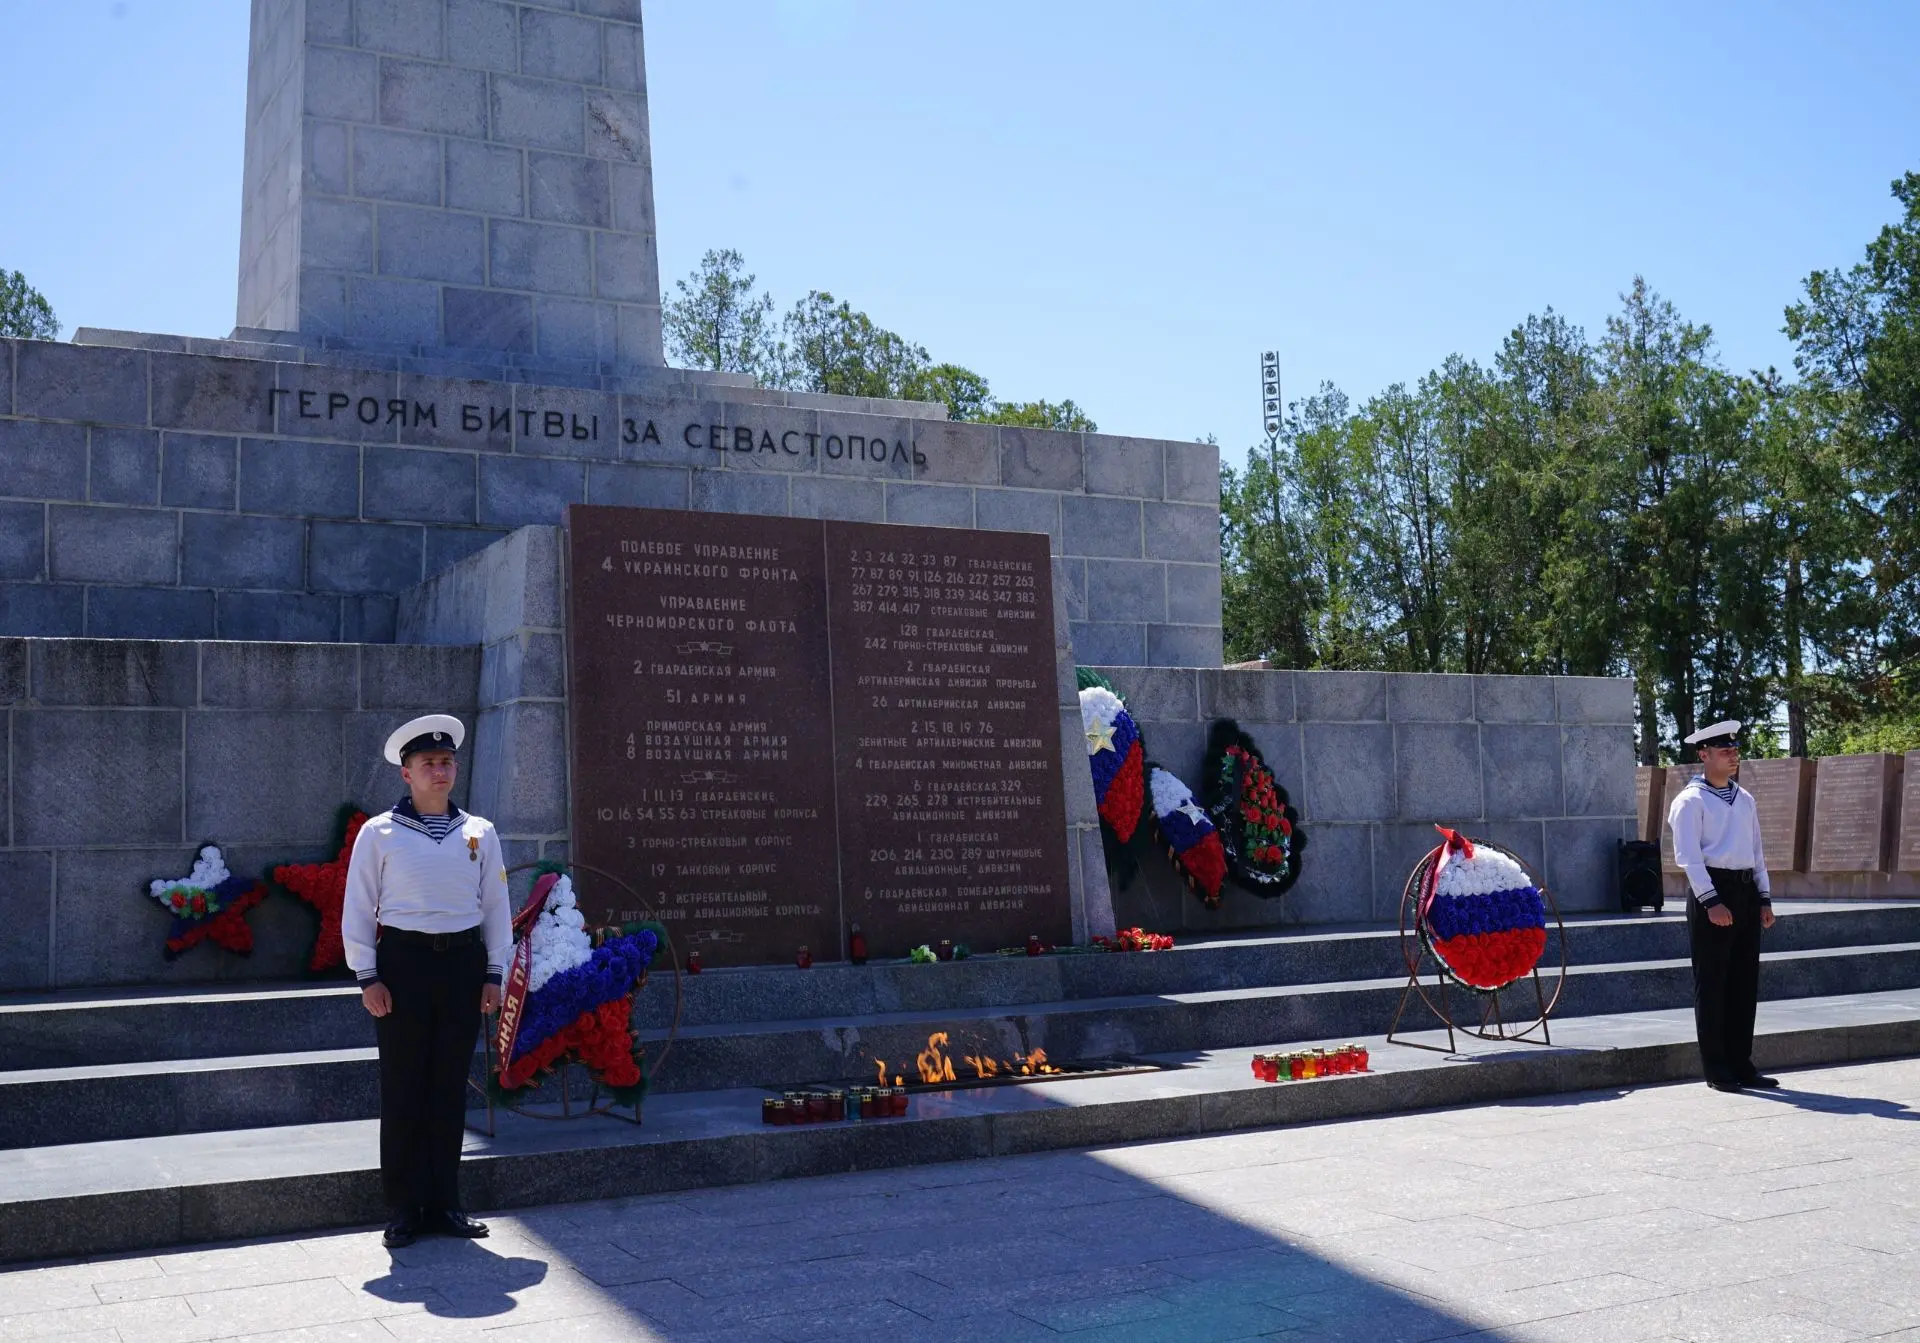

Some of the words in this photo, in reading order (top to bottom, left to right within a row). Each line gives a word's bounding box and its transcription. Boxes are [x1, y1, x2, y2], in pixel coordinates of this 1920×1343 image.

[268, 388, 437, 429] ГЕРОЯМ
[462, 404, 598, 441] БИТВЫ
[622, 418, 661, 445] ЗА
[684, 423, 927, 466] СЕВАСТОПОЛЬ
[621, 540, 682, 556] ПОЛЕВОЕ
[694, 543, 779, 561] УПРАВЛЕНИЕ
[601, 556, 613, 572] 4
[624, 560, 729, 579] УКРАИНСКОГО
[739, 567, 798, 582] ФРОНТА
[659, 595, 747, 612] УПРАВЛЕНИЕ
[902, 602, 920, 615] 417
[930, 606, 988, 618] СТРЕЛКОВЫЕ
[997, 609, 1036, 620] ДИВИЗИИ
[606, 614, 735, 632] ЧЕРНОМОРСКОГО
[745, 619, 797, 635] ФЛОТА
[901, 623, 918, 637] 128
[864, 637, 887, 649] 242
[893, 640, 984, 652] ГОРНО-СТРЕЛКОВЫЕ
[989, 643, 1029, 654] ДИВИЗИИ
[633, 660, 643, 675] 2
[739, 666, 776, 678] АРМИЯ
[907, 660, 914, 672] 2
[947, 677, 988, 688] ДИВИЗИЯ
[996, 679, 1037, 689] ПРОРЫВА
[666, 689, 681, 704] 51
[691, 693, 746, 705] АРМИЯ
[872, 695, 888, 708] 26
[987, 700, 1026, 710] ДИВИЗИЯ
[646, 720, 722, 733] ПРИМОРСКАЯ
[729, 721, 767, 733] АРМИЯ
[979, 721, 994, 733] 76
[626, 732, 635, 745] 4
[645, 735, 732, 746] ВОЗДУШНАЯ
[743, 735, 788, 746] АРМИЯ
[858, 737, 908, 747] ЗЕНИТНЫЕ
[1003, 738, 1043, 748] ДИВИЗИИ
[626, 746, 636, 760] 8
[645, 749, 732, 761] ВОЗДУШНАЯ
[743, 750, 788, 761] АРМИЯ
[855, 757, 863, 770] 4
[942, 760, 1001, 769] МИНОМЕТНАЯ
[1008, 760, 1048, 770] ДИВИЗИЯ
[956, 795, 1042, 806] ИСТРЕБИТЕЛЬНЫЕ
[702, 809, 767, 820] СТРЕЛКОВЫЕ
[774, 808, 818, 819] КОРПУСА
[892, 810, 965, 821] АВИАЦИОННЫЕ
[975, 810, 1019, 820] ДИВИЗИИ
[627, 837, 635, 849] 3
[755, 835, 793, 847] КОРПУС
[986, 849, 1043, 859] ШТУРМОВЫЕ
[651, 863, 665, 878] 19
[739, 862, 777, 874] КОРПУС
[894, 864, 968, 876] АВИАЦИОННЫЕ
[978, 863, 1021, 874] ДИВИЗИИ
[658, 891, 666, 904] 3
[864, 887, 873, 900] 6
[957, 885, 1051, 896] БОМБАРДИРОВОЧНАЯ
[898, 901, 969, 913] АВИАЦИОННАЯ
[980, 901, 1024, 911] ДИВИЗИЯ
[606, 909, 614, 922] 7
[694, 907, 769, 920] АВИАЦИОННЫЕ
[775, 907, 822, 917] КОРПУСА
[500, 994, 519, 1063] ЧНАЯ
